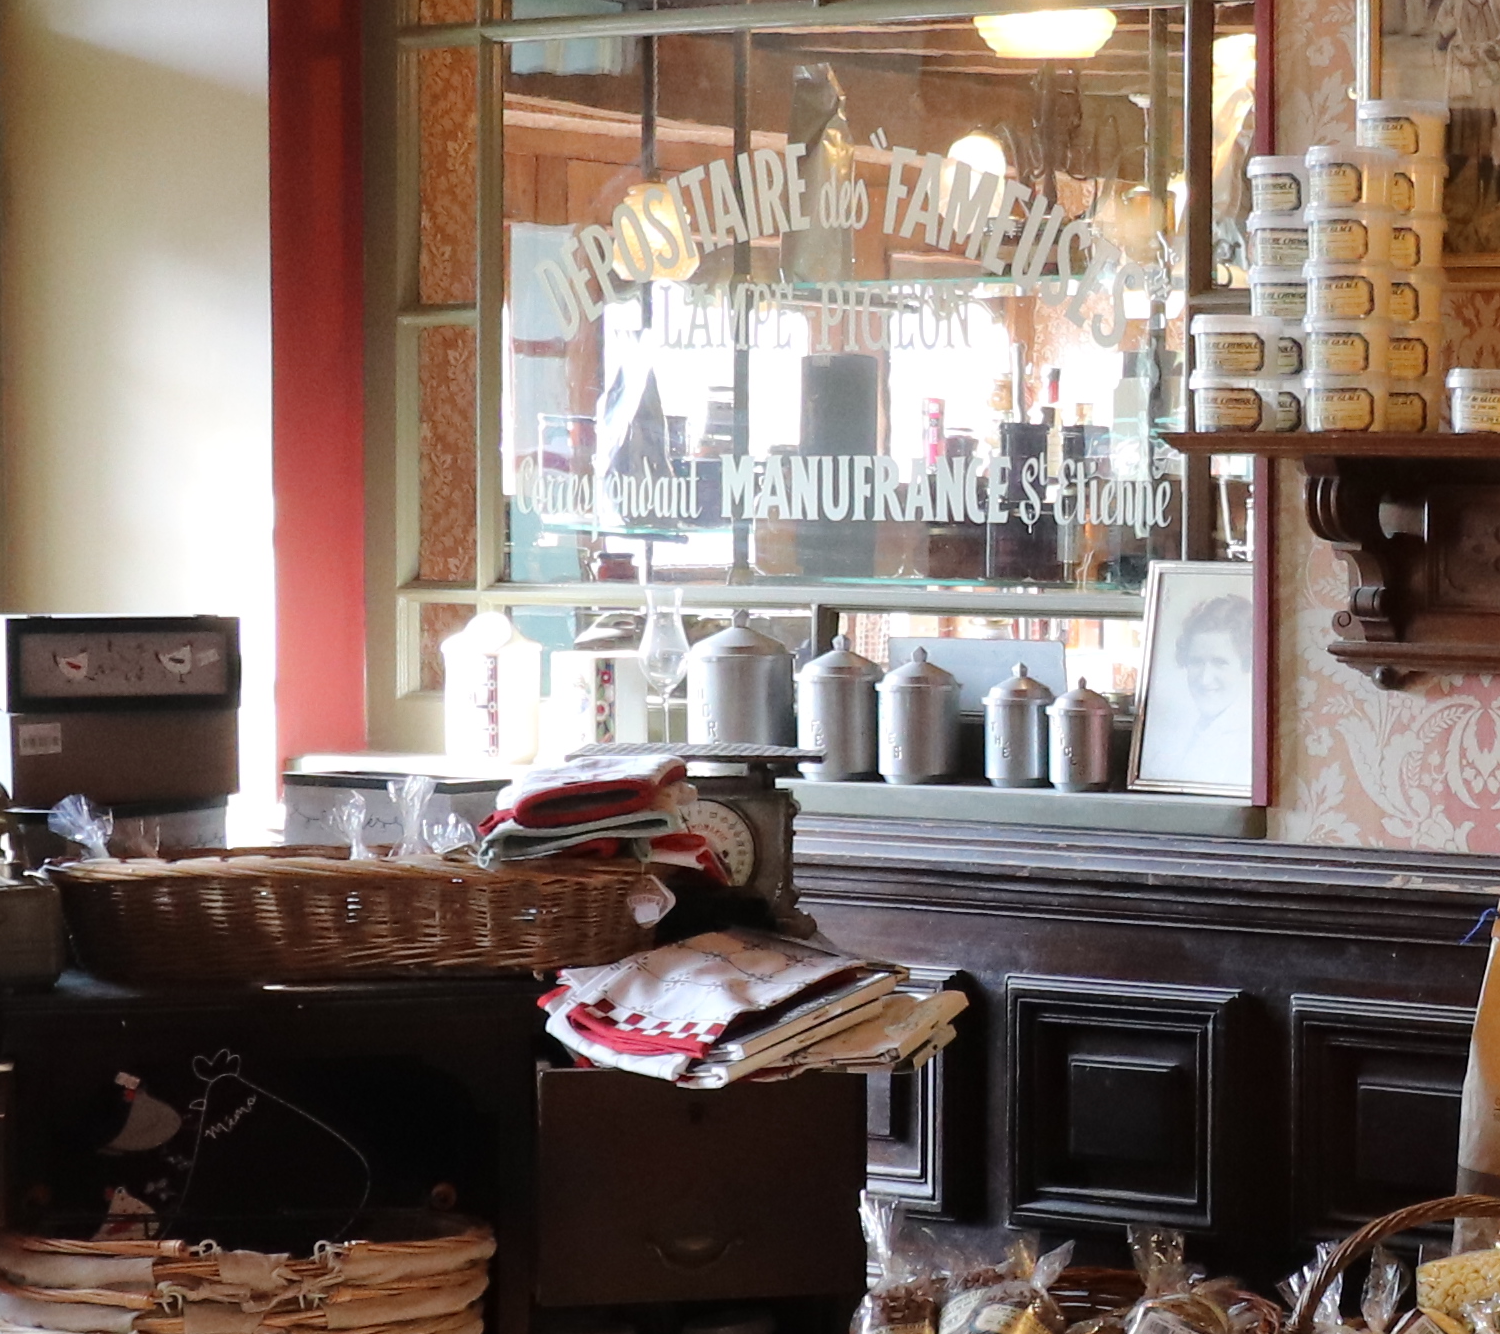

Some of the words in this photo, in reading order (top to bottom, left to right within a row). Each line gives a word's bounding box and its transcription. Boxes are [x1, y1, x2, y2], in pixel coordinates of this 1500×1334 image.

[820, 165, 869, 229] des
[514, 454, 703, 542] Correspondant
[720, 453, 1011, 523] MANUFRANCE
